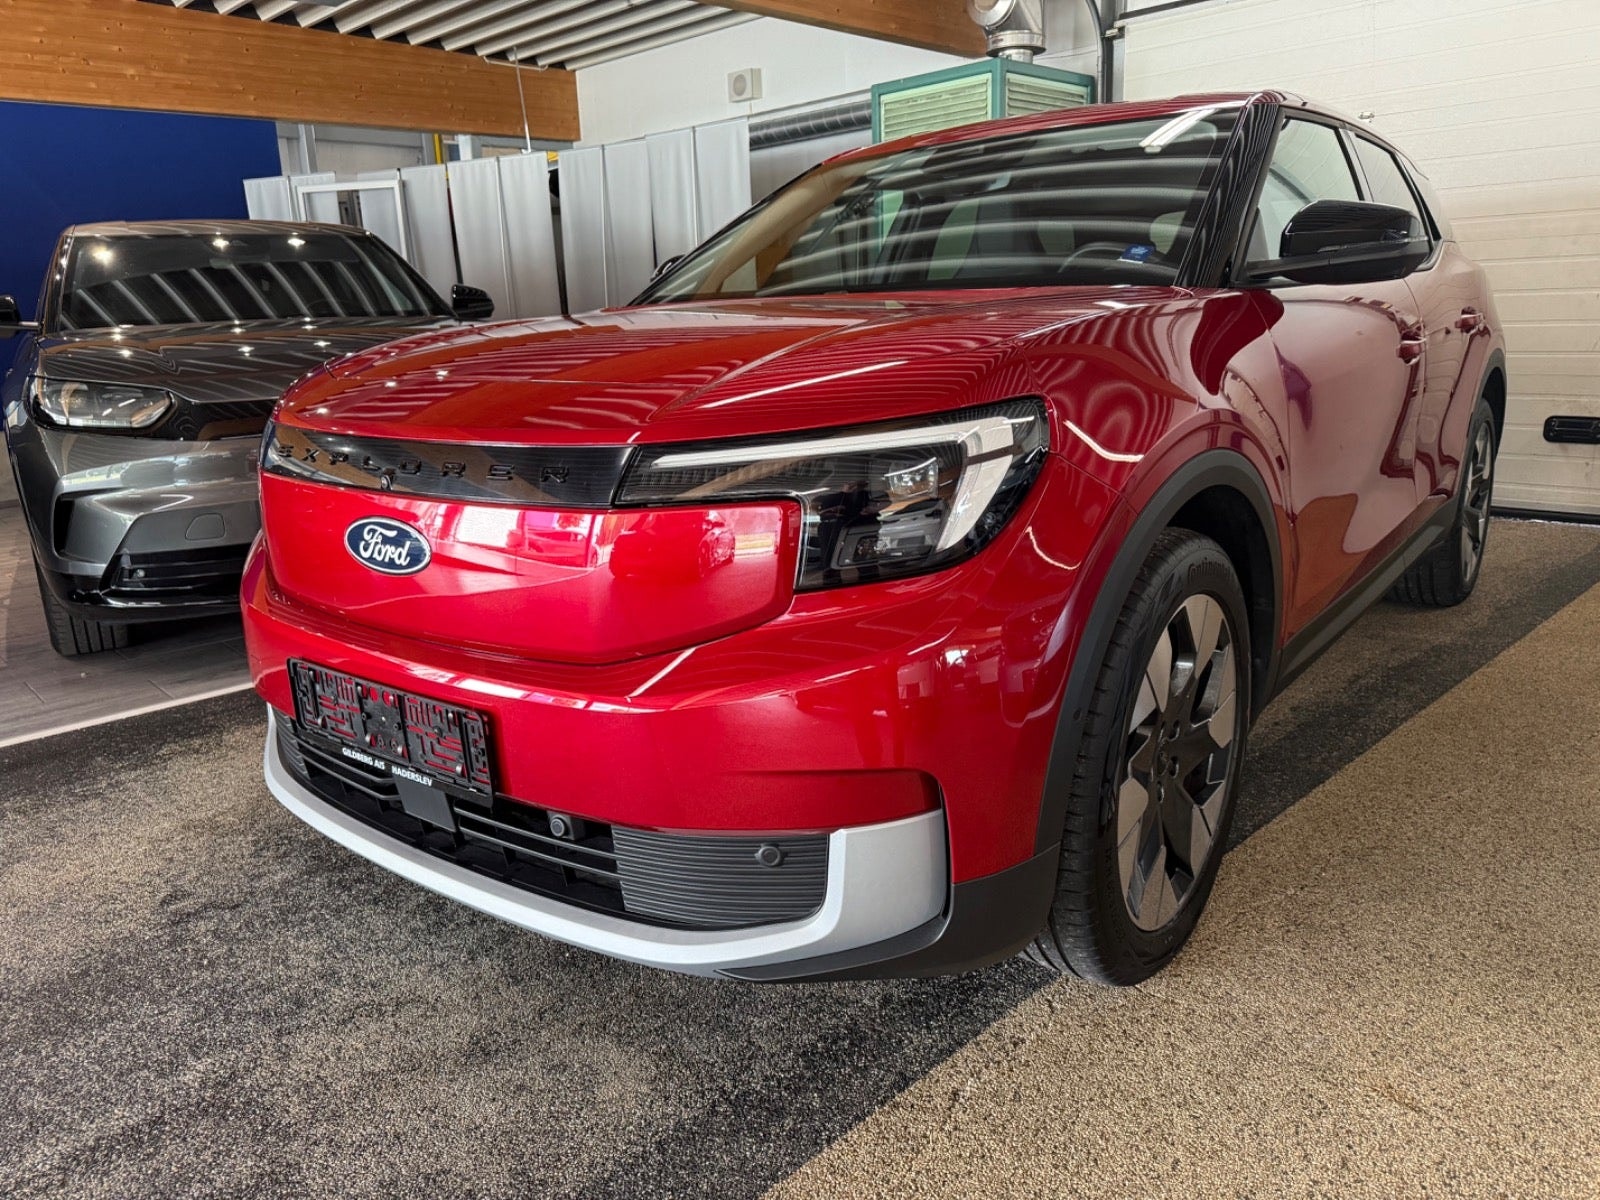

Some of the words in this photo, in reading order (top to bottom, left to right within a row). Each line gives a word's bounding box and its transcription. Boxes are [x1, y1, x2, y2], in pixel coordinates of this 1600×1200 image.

[278, 445, 569, 483] EXPLORER
[359, 524, 411, 566] Ford
[342, 747, 373, 766] GILDBERG
[391, 765, 432, 787] HADERSLEV
